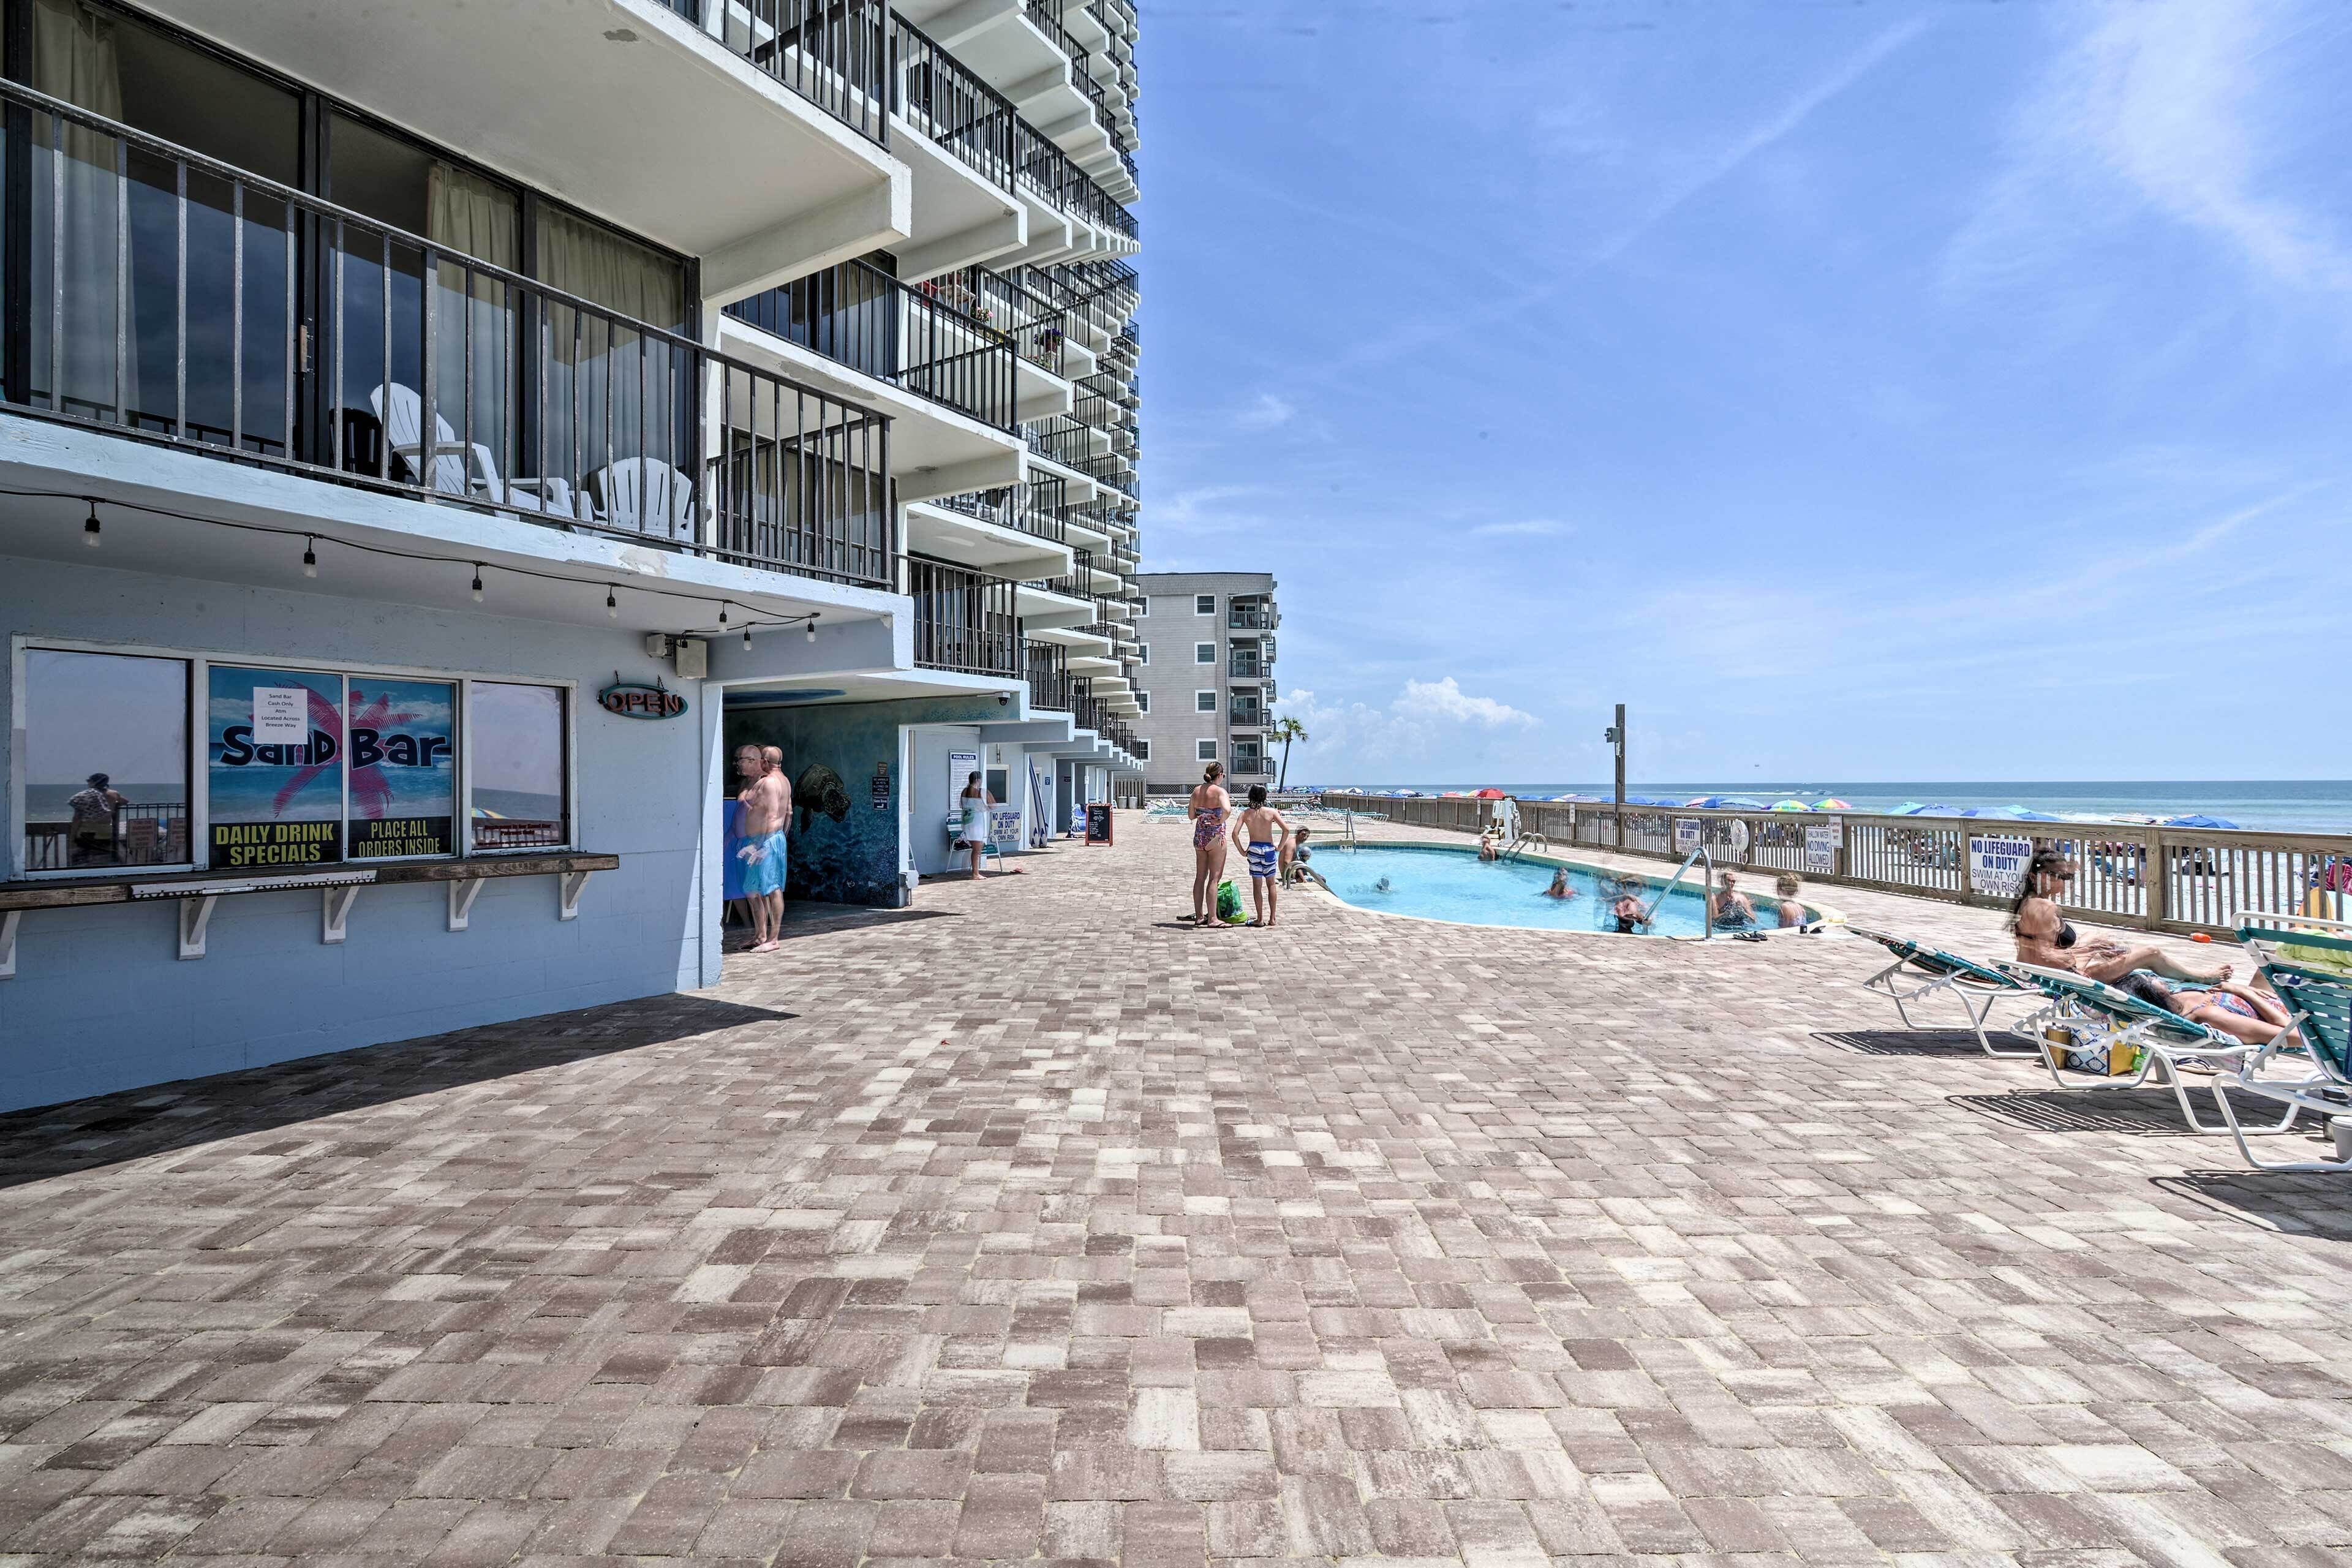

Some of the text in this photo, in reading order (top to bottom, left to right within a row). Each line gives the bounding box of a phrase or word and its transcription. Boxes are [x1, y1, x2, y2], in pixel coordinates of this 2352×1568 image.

[607, 693, 679, 712] OPEN
[350, 728, 447, 770] Bar
[1000, 812, 1020, 820] LIFEGUARD
[216, 824, 334, 845] DAILY DRINK
[371, 820, 428, 839] PLACE ALL
[230, 843, 321, 865] SPECIALS
[358, 837, 440, 858] ORDERS INSIDE
[1807, 840, 1830, 853] NO DIVING
[1971, 840, 2030, 857] NO LIFEGUARD
[1809, 854, 1829, 865] ALLOWED
[1983, 855, 2018, 871] ON DUTY
[1972, 869, 1992, 880] SWIM
[1994, 872, 2003, 880] AT
[1980, 879, 2021, 892] OWN RISK
